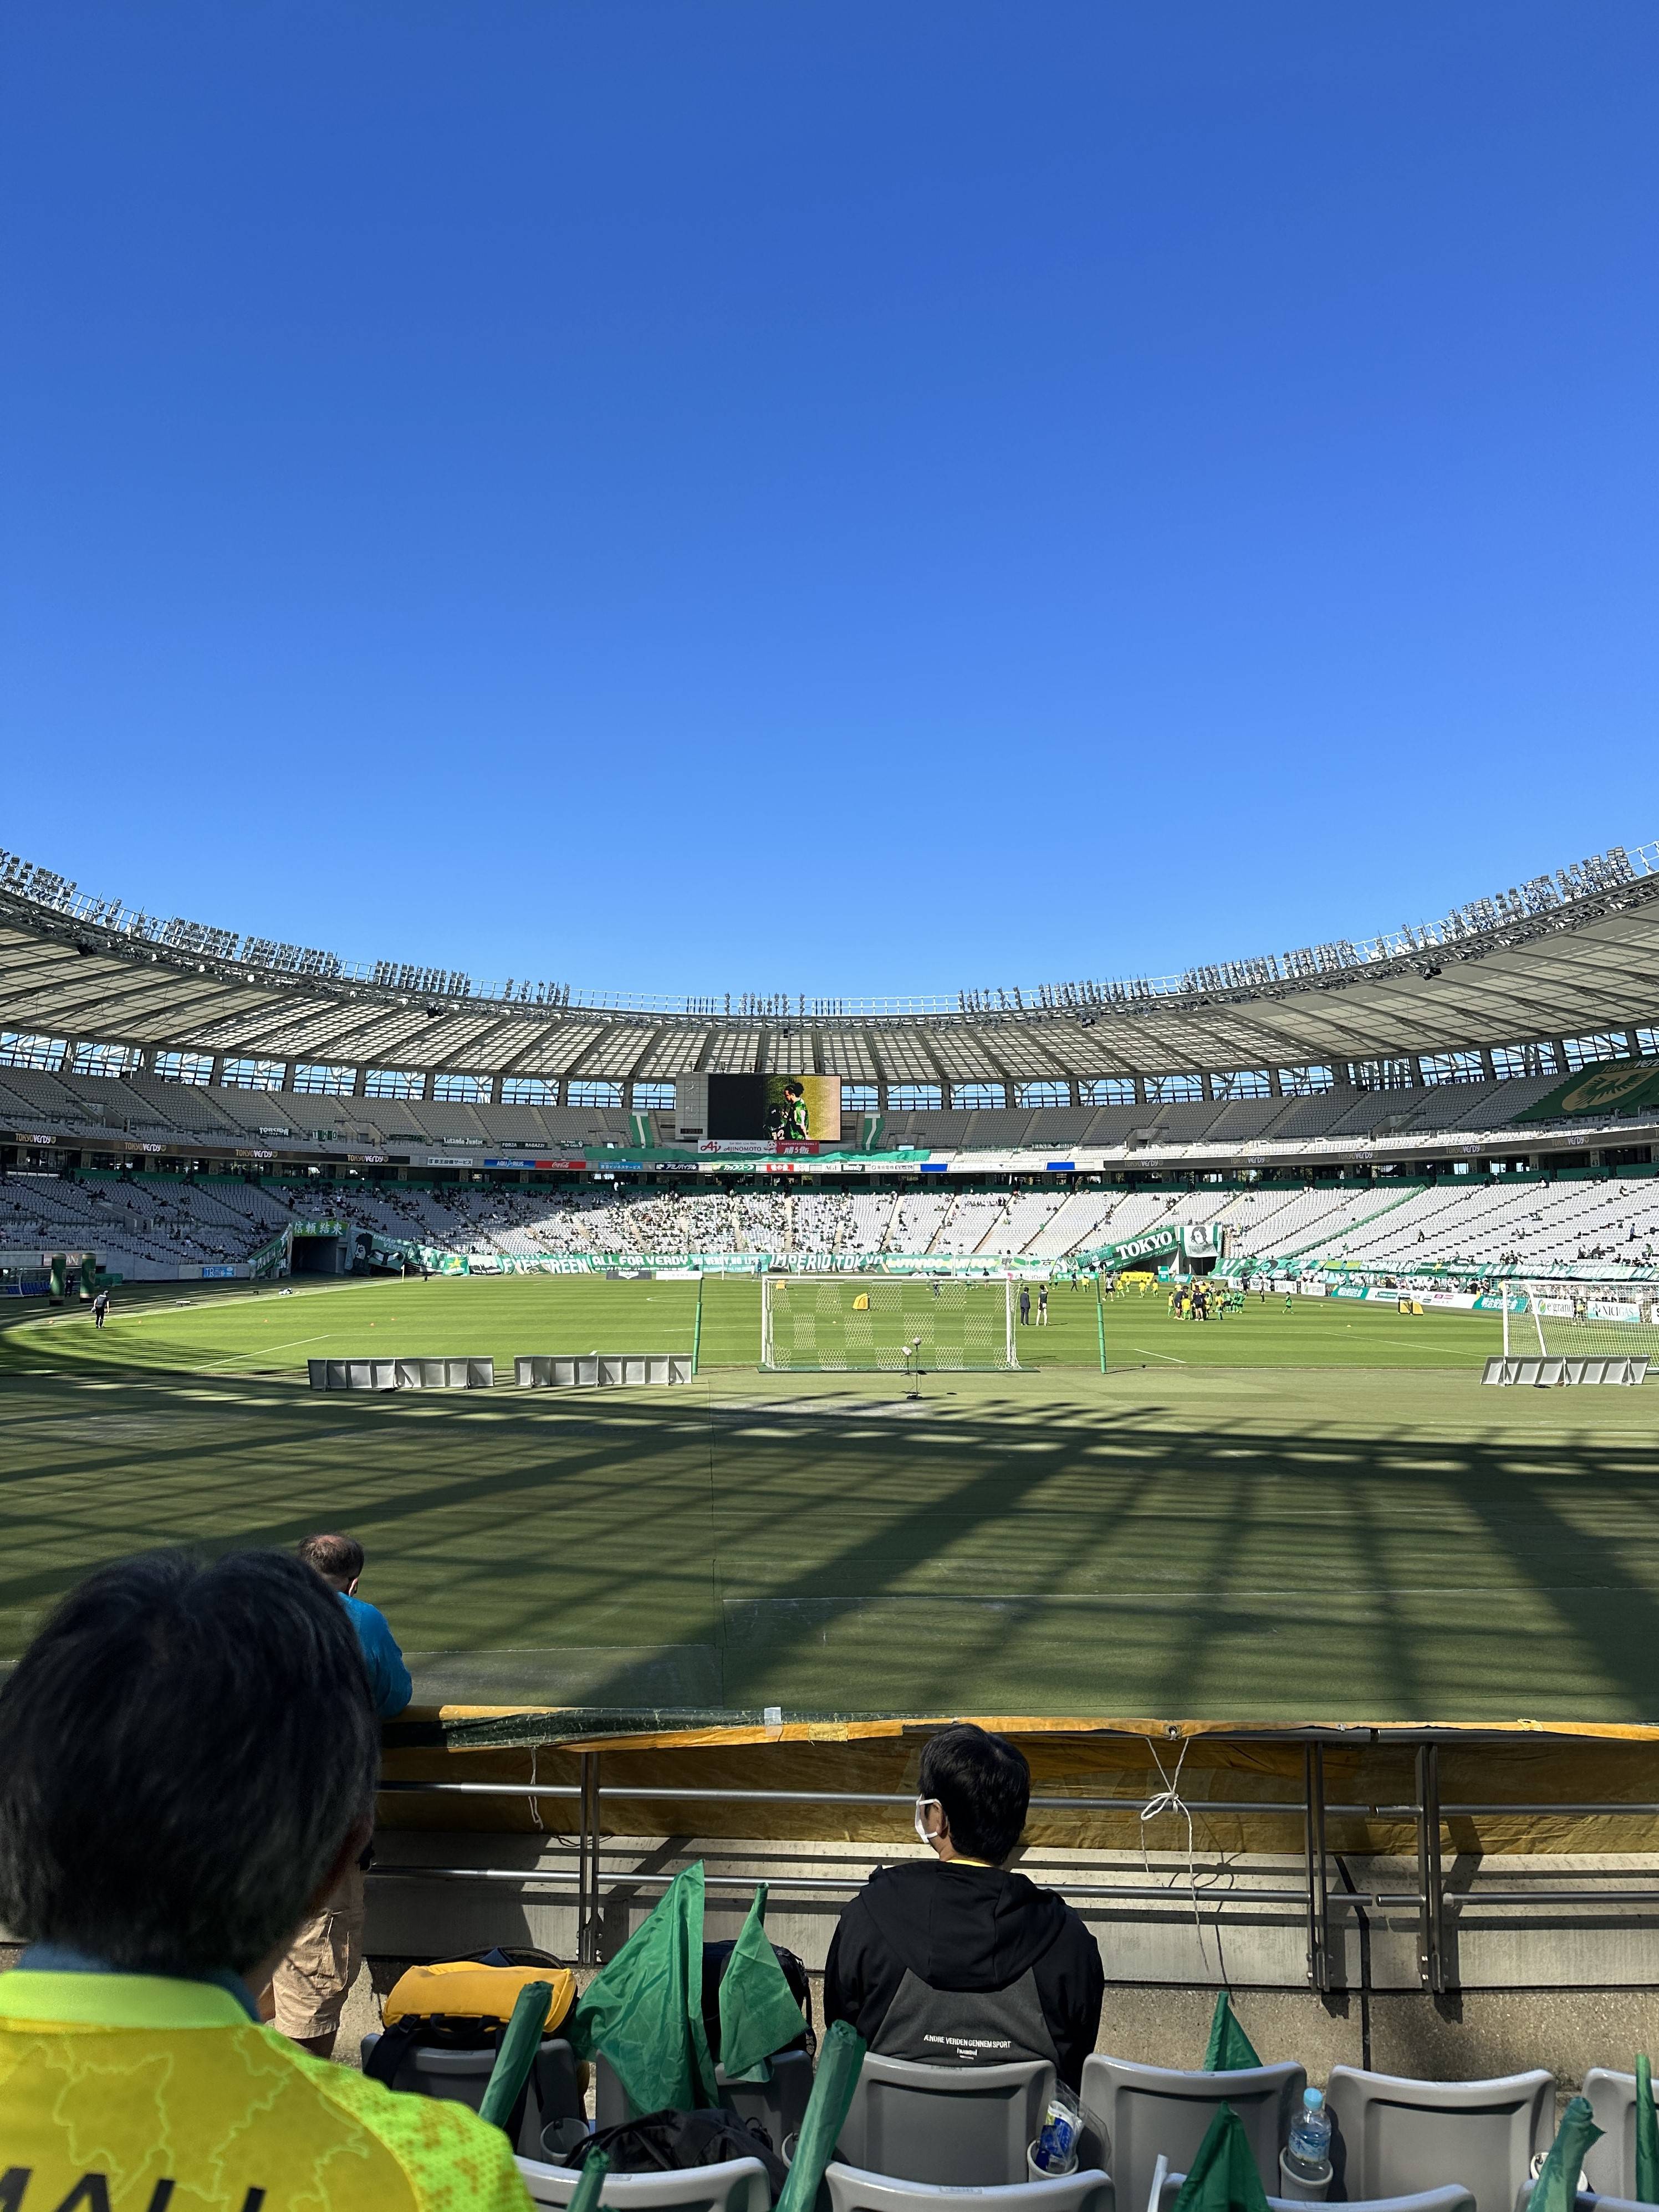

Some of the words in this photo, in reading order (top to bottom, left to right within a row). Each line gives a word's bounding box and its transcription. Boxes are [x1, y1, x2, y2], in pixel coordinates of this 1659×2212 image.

[313, 1131, 337, 1140] TOKYO
[1116, 1231, 1172, 1260] TOKYO
[592, 1256, 619, 1265] ALL
[619, 1256, 645, 1266] FOR
[646, 1255, 688, 1266] VERDY
[1602, 1305, 1634, 1316] NICIGAS
[946, 2037, 968, 2046] VERDEN
